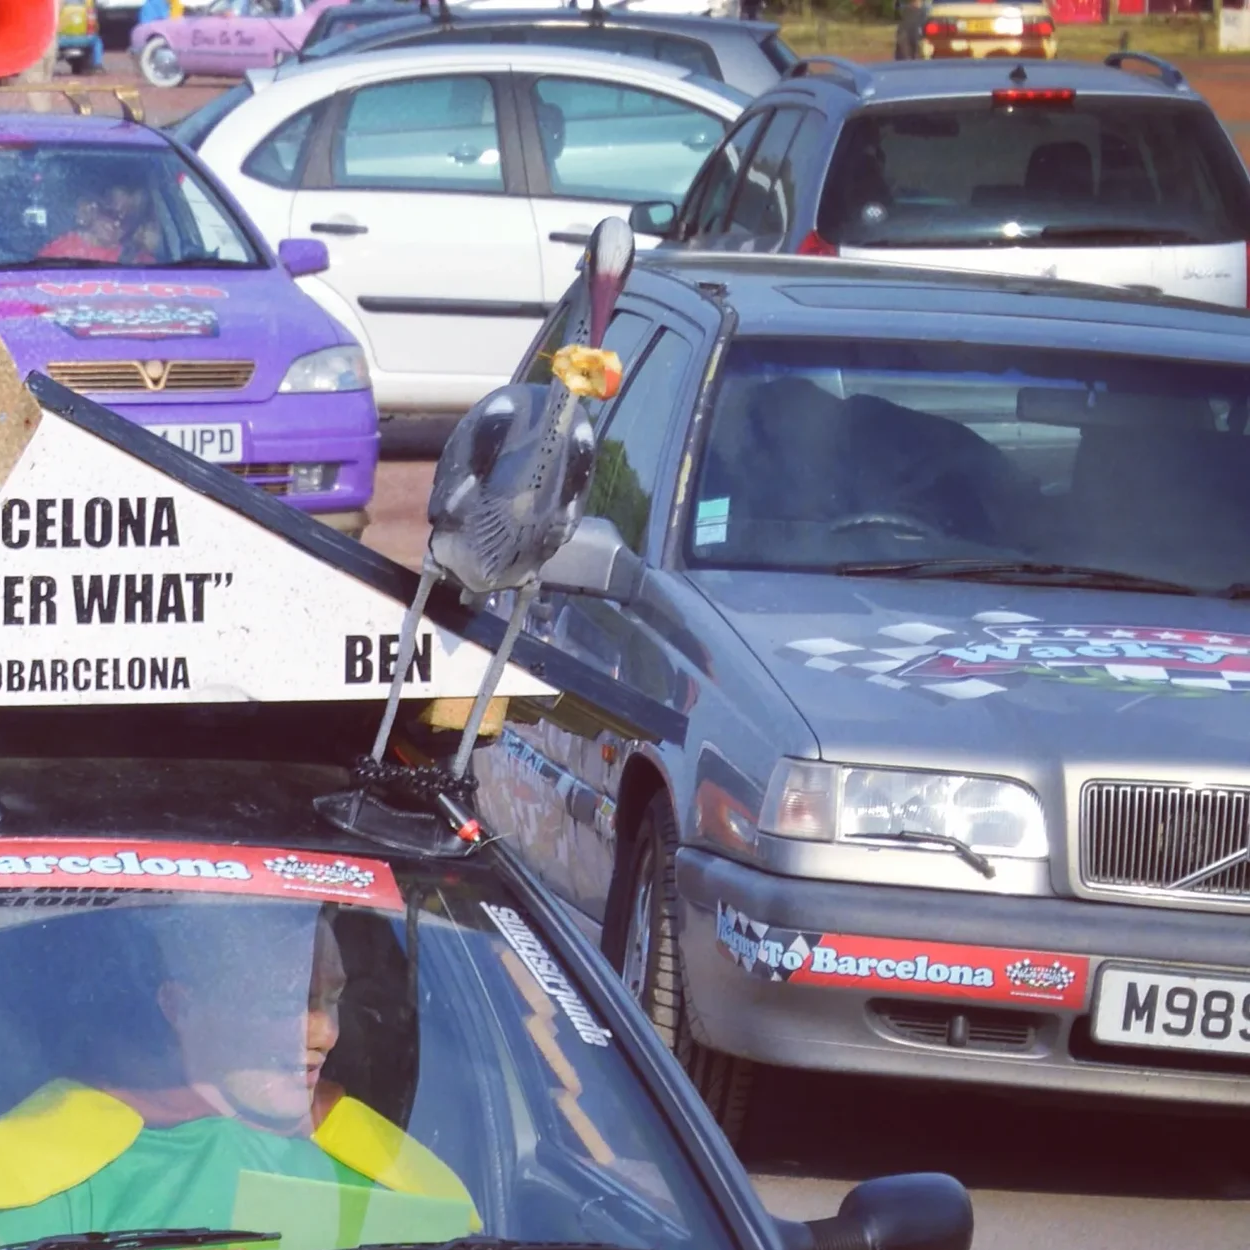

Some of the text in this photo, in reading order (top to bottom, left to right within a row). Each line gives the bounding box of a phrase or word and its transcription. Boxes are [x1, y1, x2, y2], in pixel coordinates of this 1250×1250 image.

[180, 429, 234, 456] UPD
[344, 632, 433, 685] BEN
[938, 639, 1228, 665] Wacky
[764, 938, 804, 971] To
[810, 945, 996, 988] Barcelona
